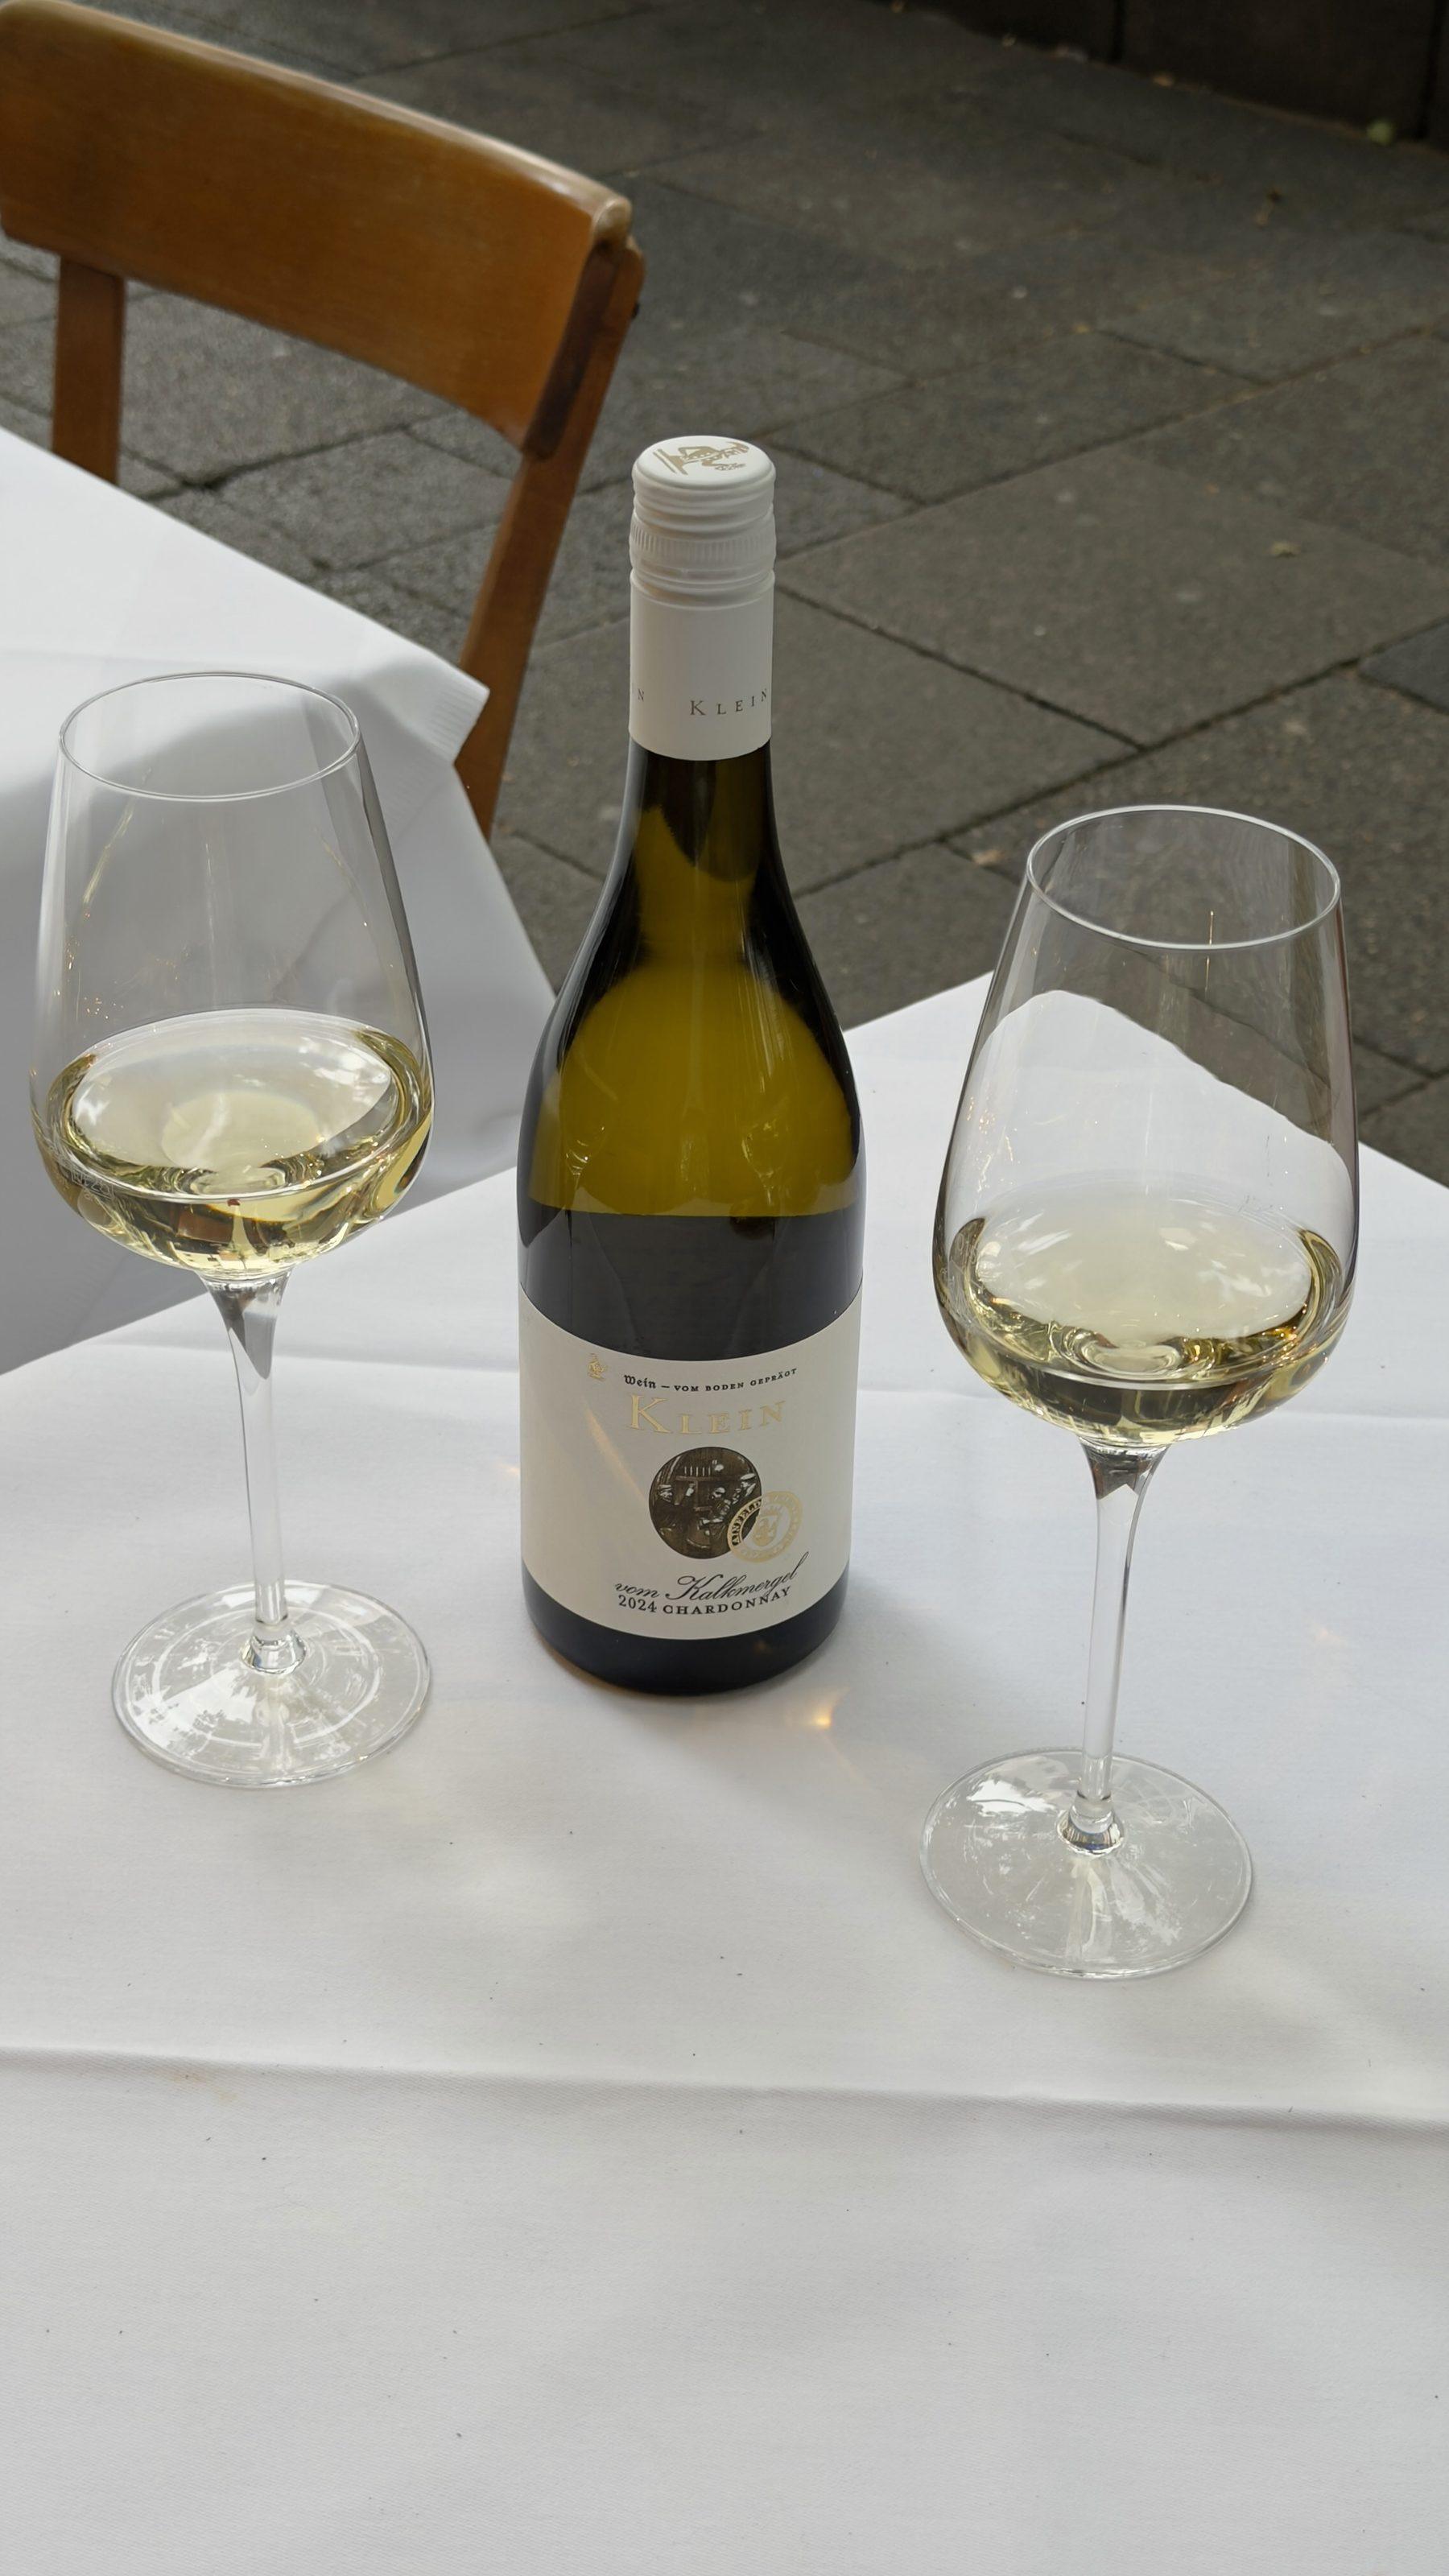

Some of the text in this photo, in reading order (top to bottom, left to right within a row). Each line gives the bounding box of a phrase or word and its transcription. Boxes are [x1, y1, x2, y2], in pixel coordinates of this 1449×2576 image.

[689, 688, 767, 716] KLEIN
[624, 1374, 657, 1389] Wein
[705, 1382, 744, 1392] BODEN
[750, 1368, 797, 1387] GEPRÄGT
[627, 1393, 786, 1435] KLEIN
[614, 1551, 809, 1601] vom Kalkmergel
[618, 1586, 791, 1615] 2024 CHARDONNAY
